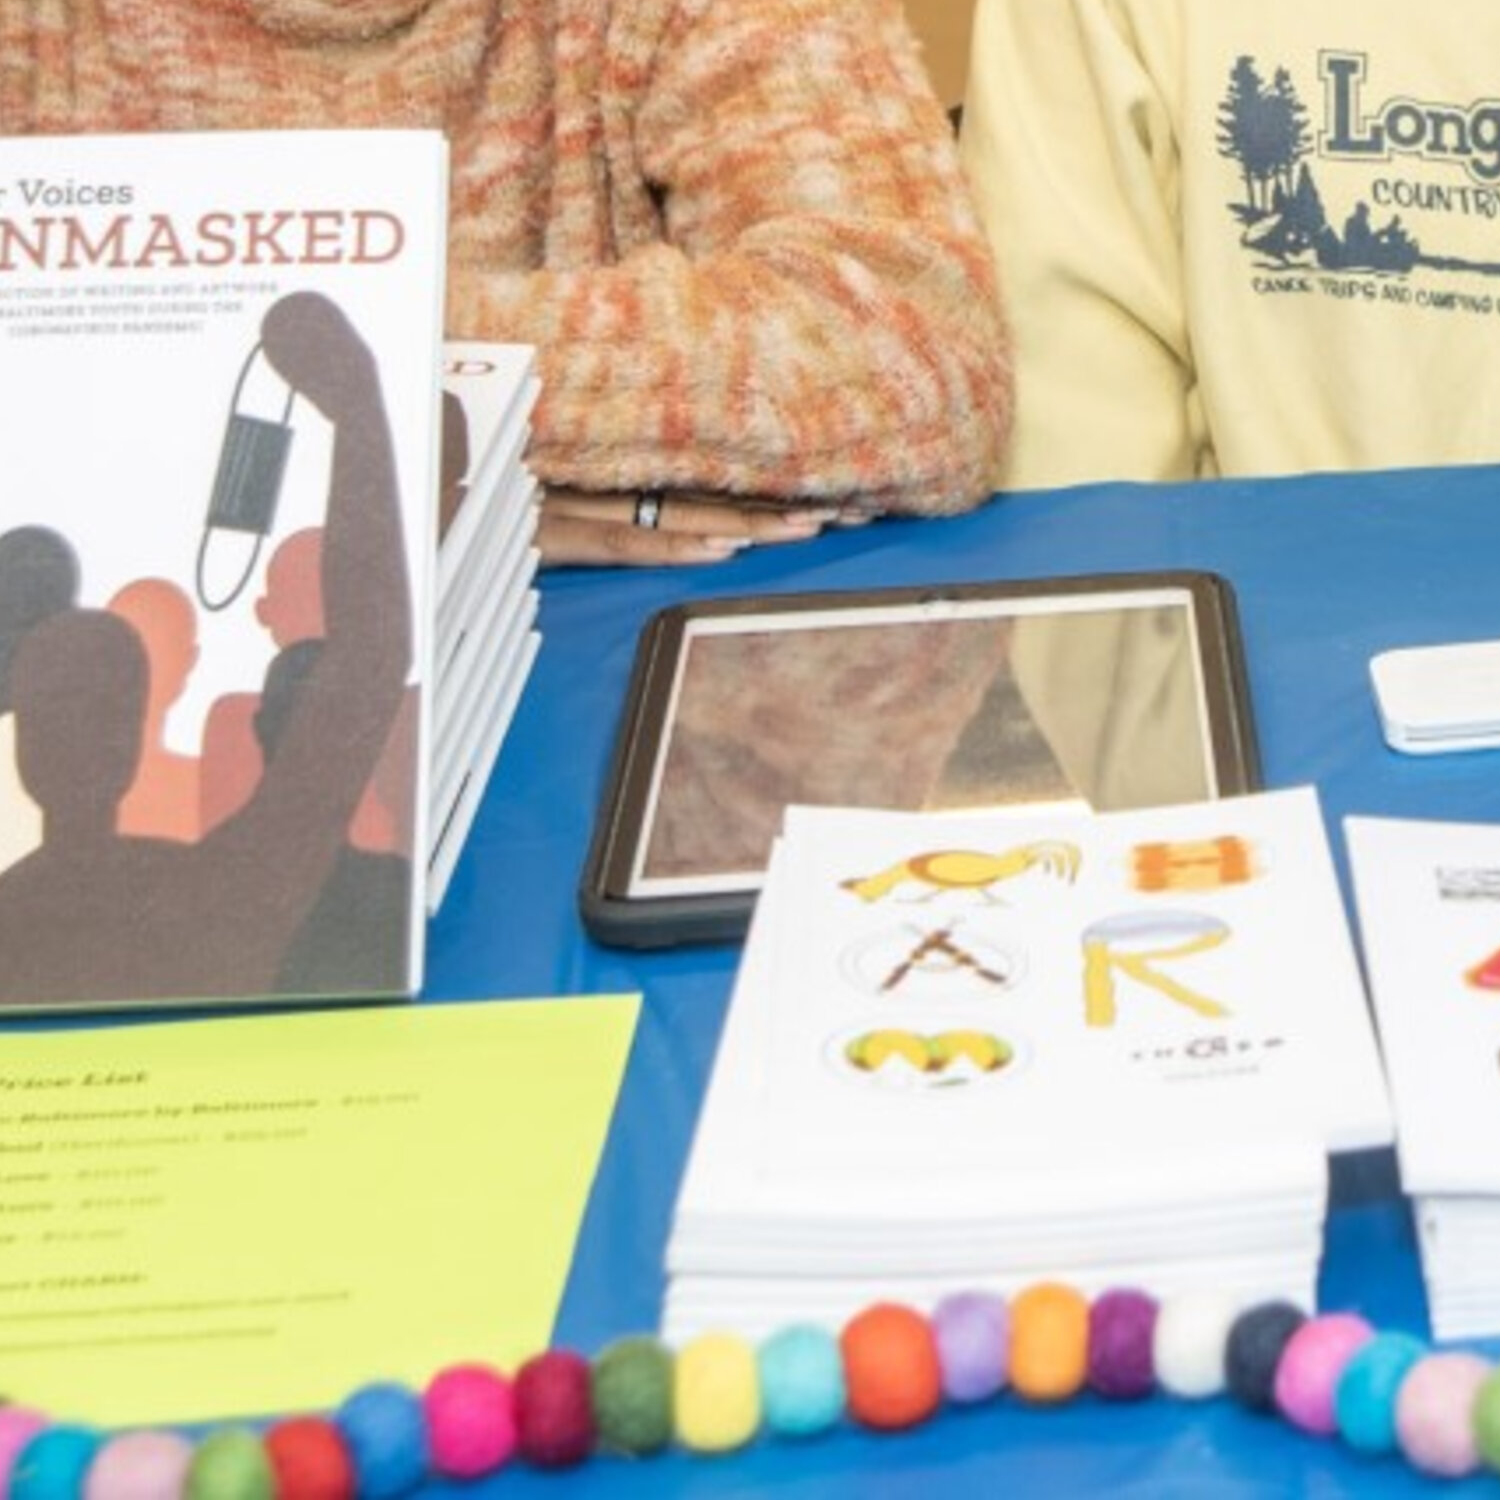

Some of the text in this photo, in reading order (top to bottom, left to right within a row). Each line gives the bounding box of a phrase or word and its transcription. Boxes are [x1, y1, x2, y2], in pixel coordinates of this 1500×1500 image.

[18, 178, 135, 207] Voices
[0, 209, 407, 272] NMASKED
[1317, 276, 1376, 300] TRIPS
[1381, 283, 1413, 304] AND
[1415, 288, 1492, 315] CAMPING
